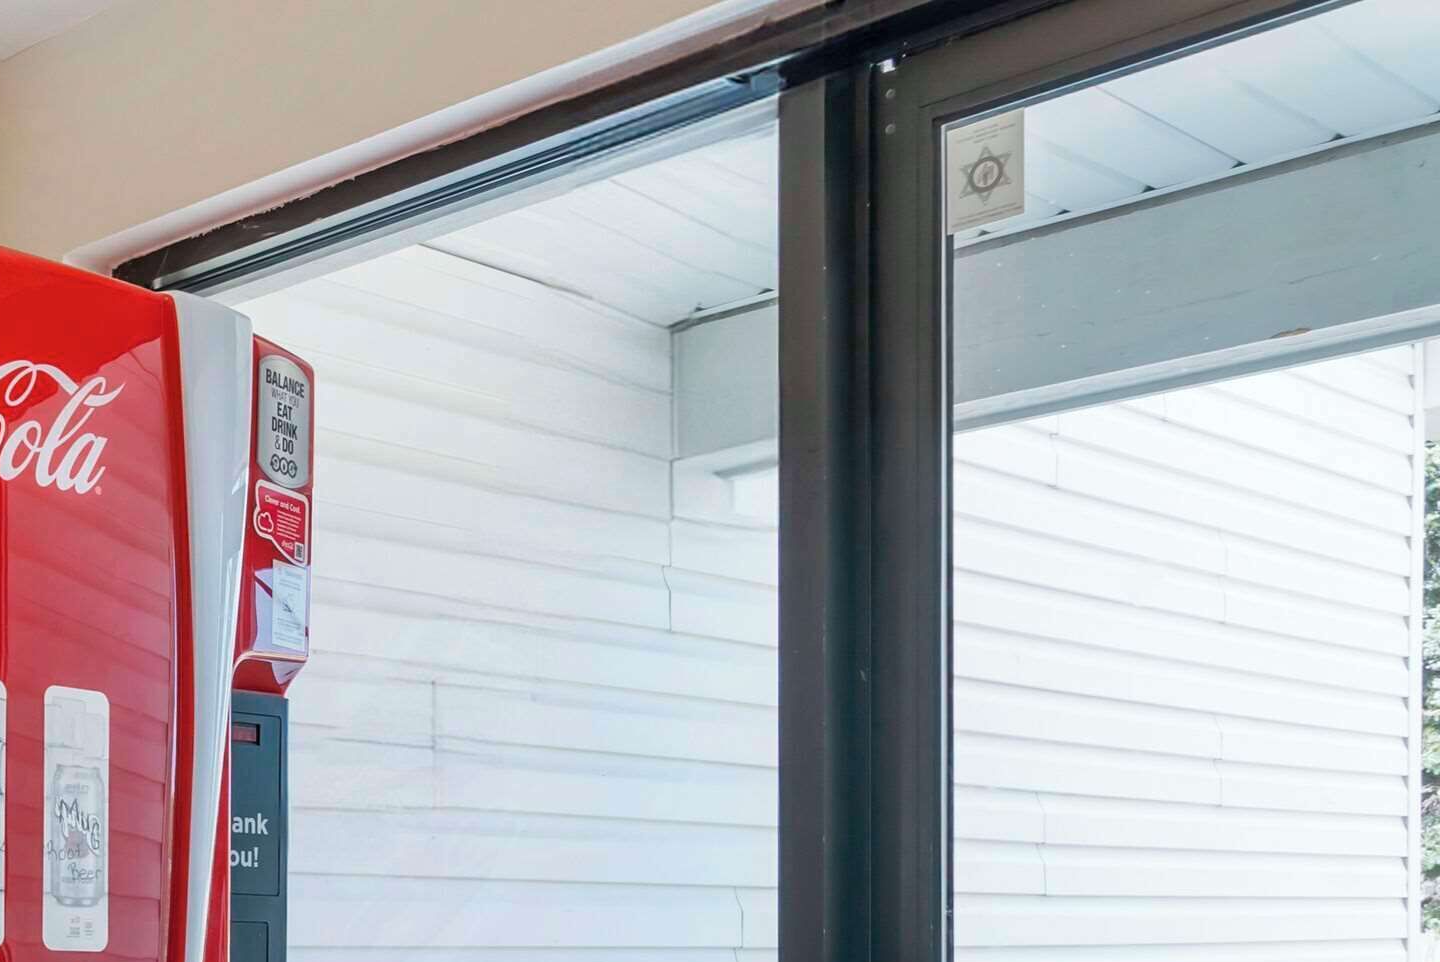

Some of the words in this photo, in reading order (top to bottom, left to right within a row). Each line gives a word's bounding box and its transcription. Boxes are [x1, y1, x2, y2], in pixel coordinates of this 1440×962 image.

[266, 368, 305, 399] BALANCE
[277, 402, 293, 421] EAT
[271, 416, 298, 441] DRINK
[275, 435, 281, 450] &
[282, 437, 294, 455] DO
[231, 812, 269, 836] ank
[230, 846, 259, 868] ou!
[67, 861, 103, 882] Beer
